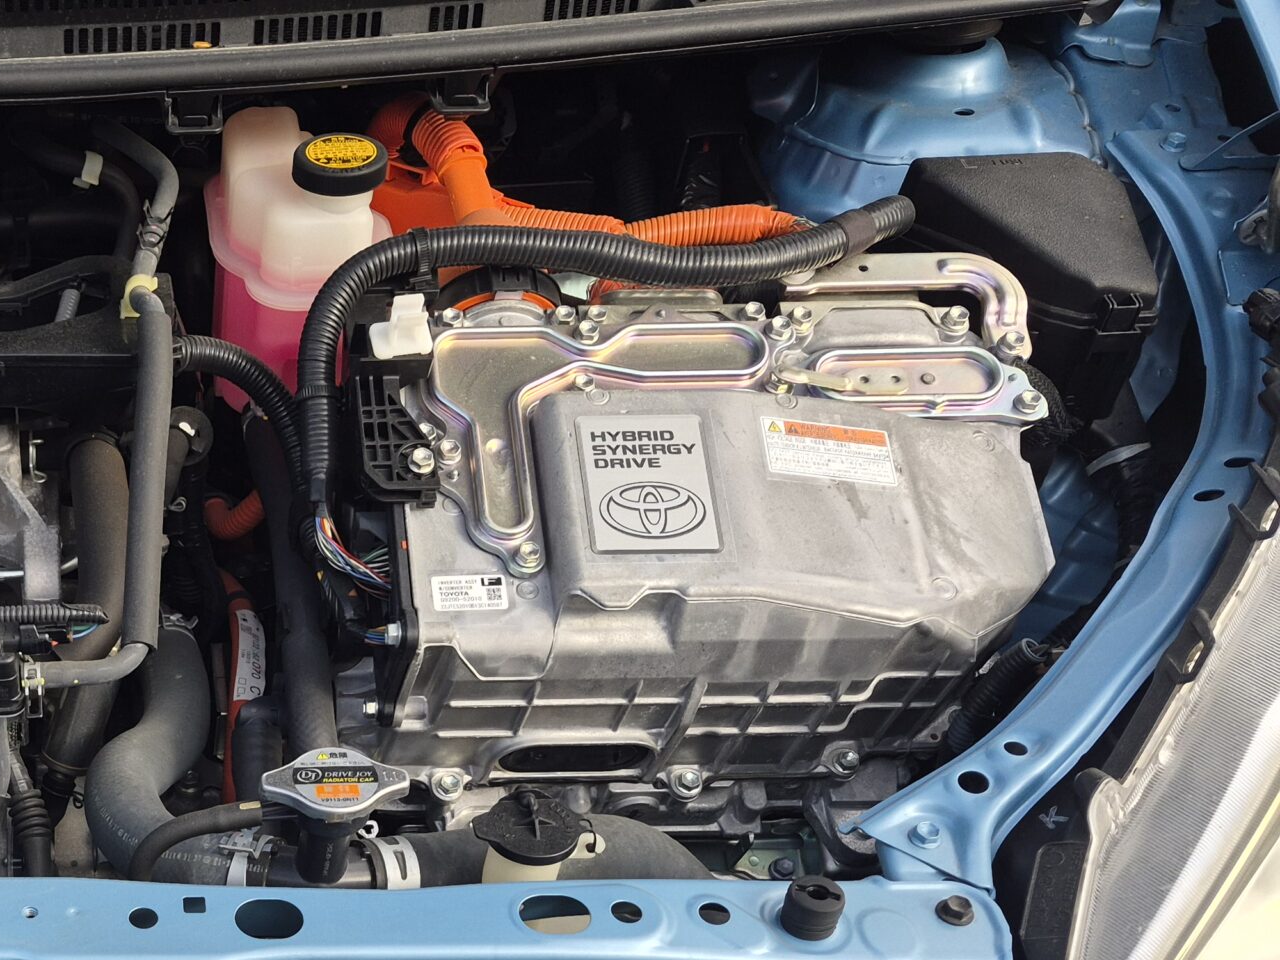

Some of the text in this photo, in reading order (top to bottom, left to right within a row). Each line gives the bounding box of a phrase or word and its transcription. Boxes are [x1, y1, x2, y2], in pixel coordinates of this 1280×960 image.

[590, 430, 674, 442] HYBRID
[592, 443, 696, 456] SYNERGY
[594, 457, 662, 469] DRIVE
